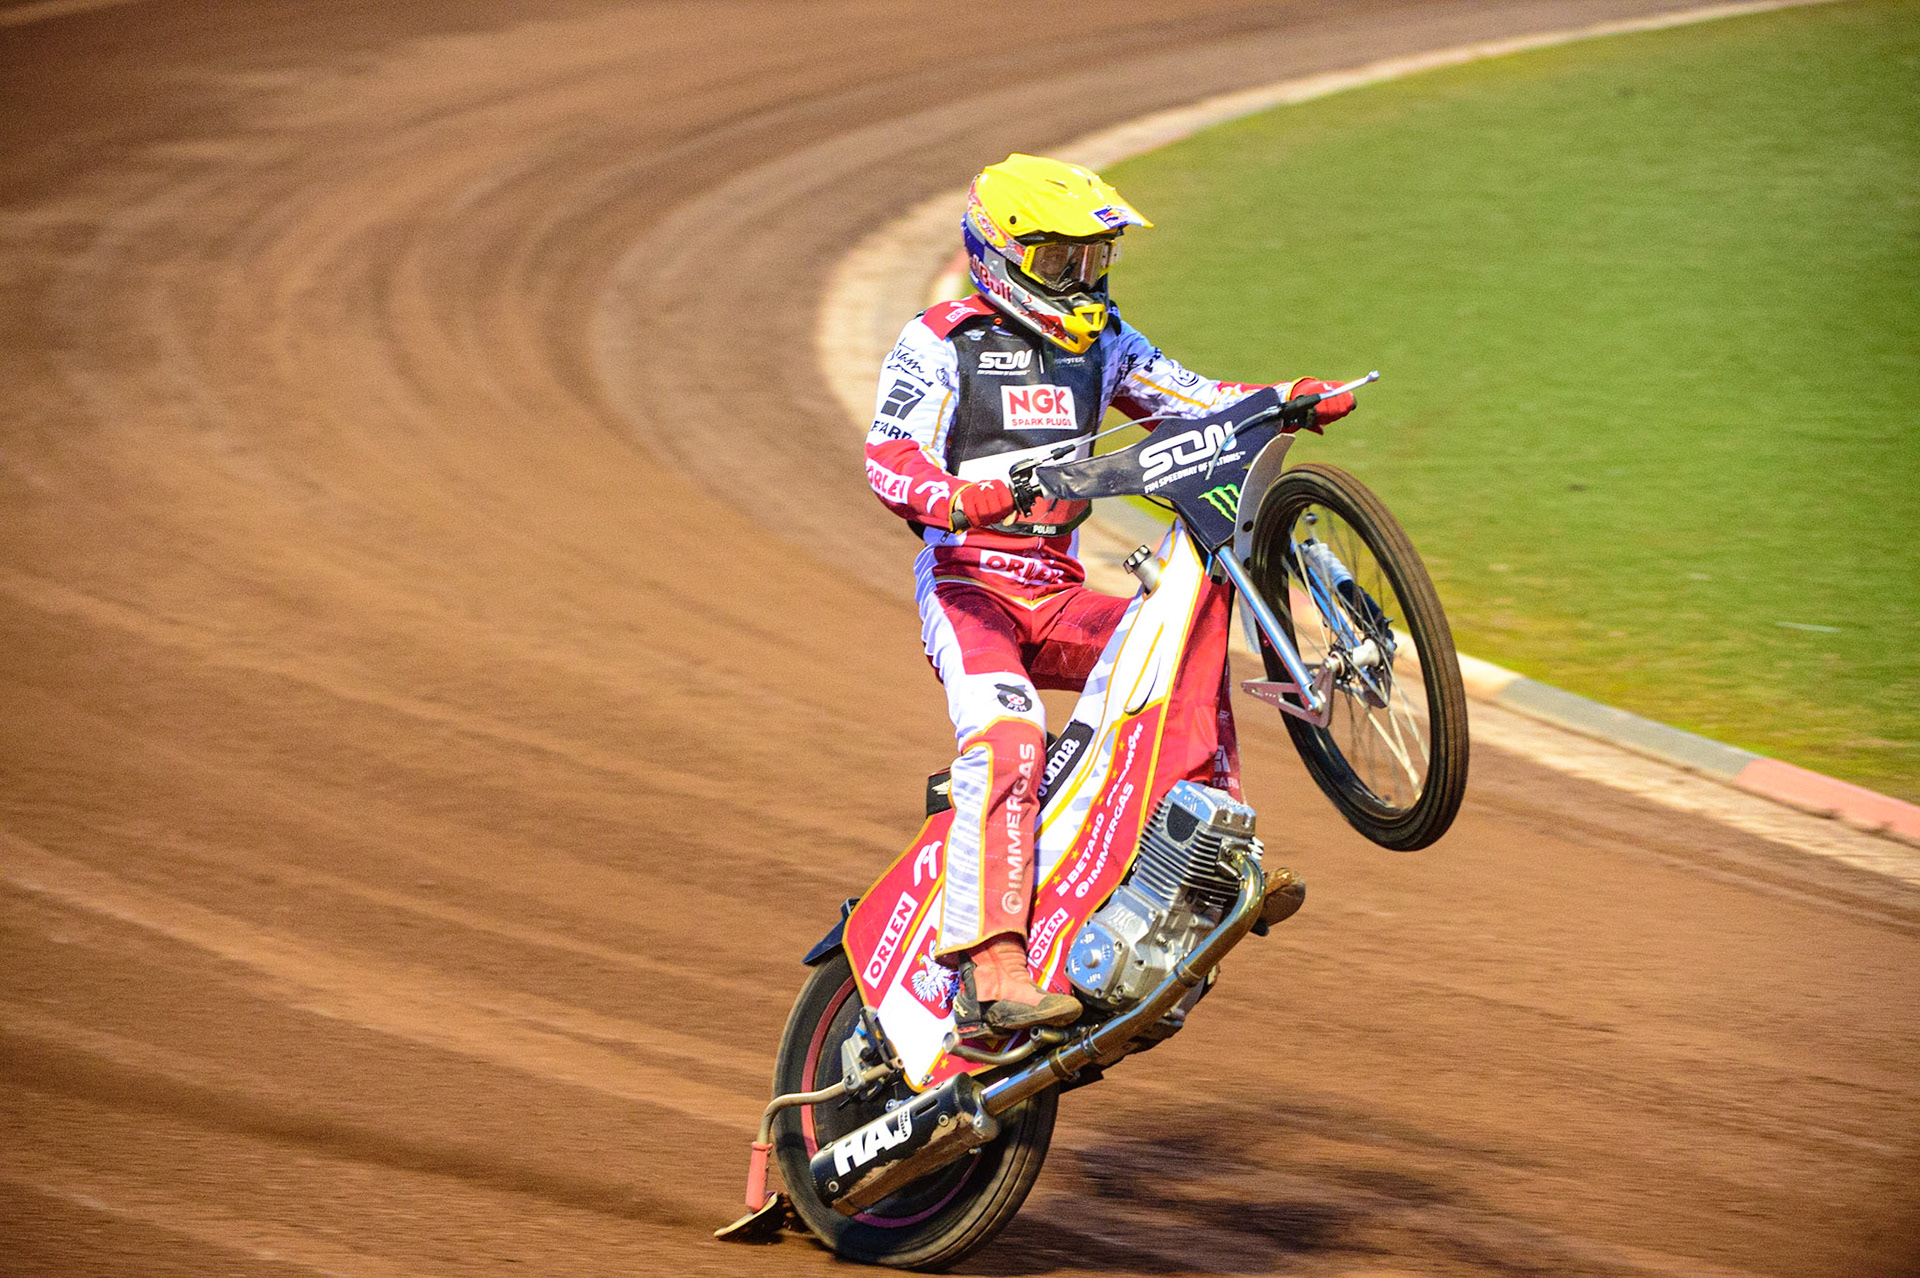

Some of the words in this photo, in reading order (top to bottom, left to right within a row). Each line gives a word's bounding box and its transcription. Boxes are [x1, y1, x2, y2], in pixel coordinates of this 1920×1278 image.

[1009, 389, 1069, 415] NGK
[1012, 418, 1044, 426] SPARK
[1006, 743, 1036, 889] IMMERGAS
[1067, 812, 1105, 884] BETARD
[1086, 782, 1134, 885] IMMERGAS
[870, 901, 912, 979] ORLEN
[1032, 913, 1064, 960] ORLEN
